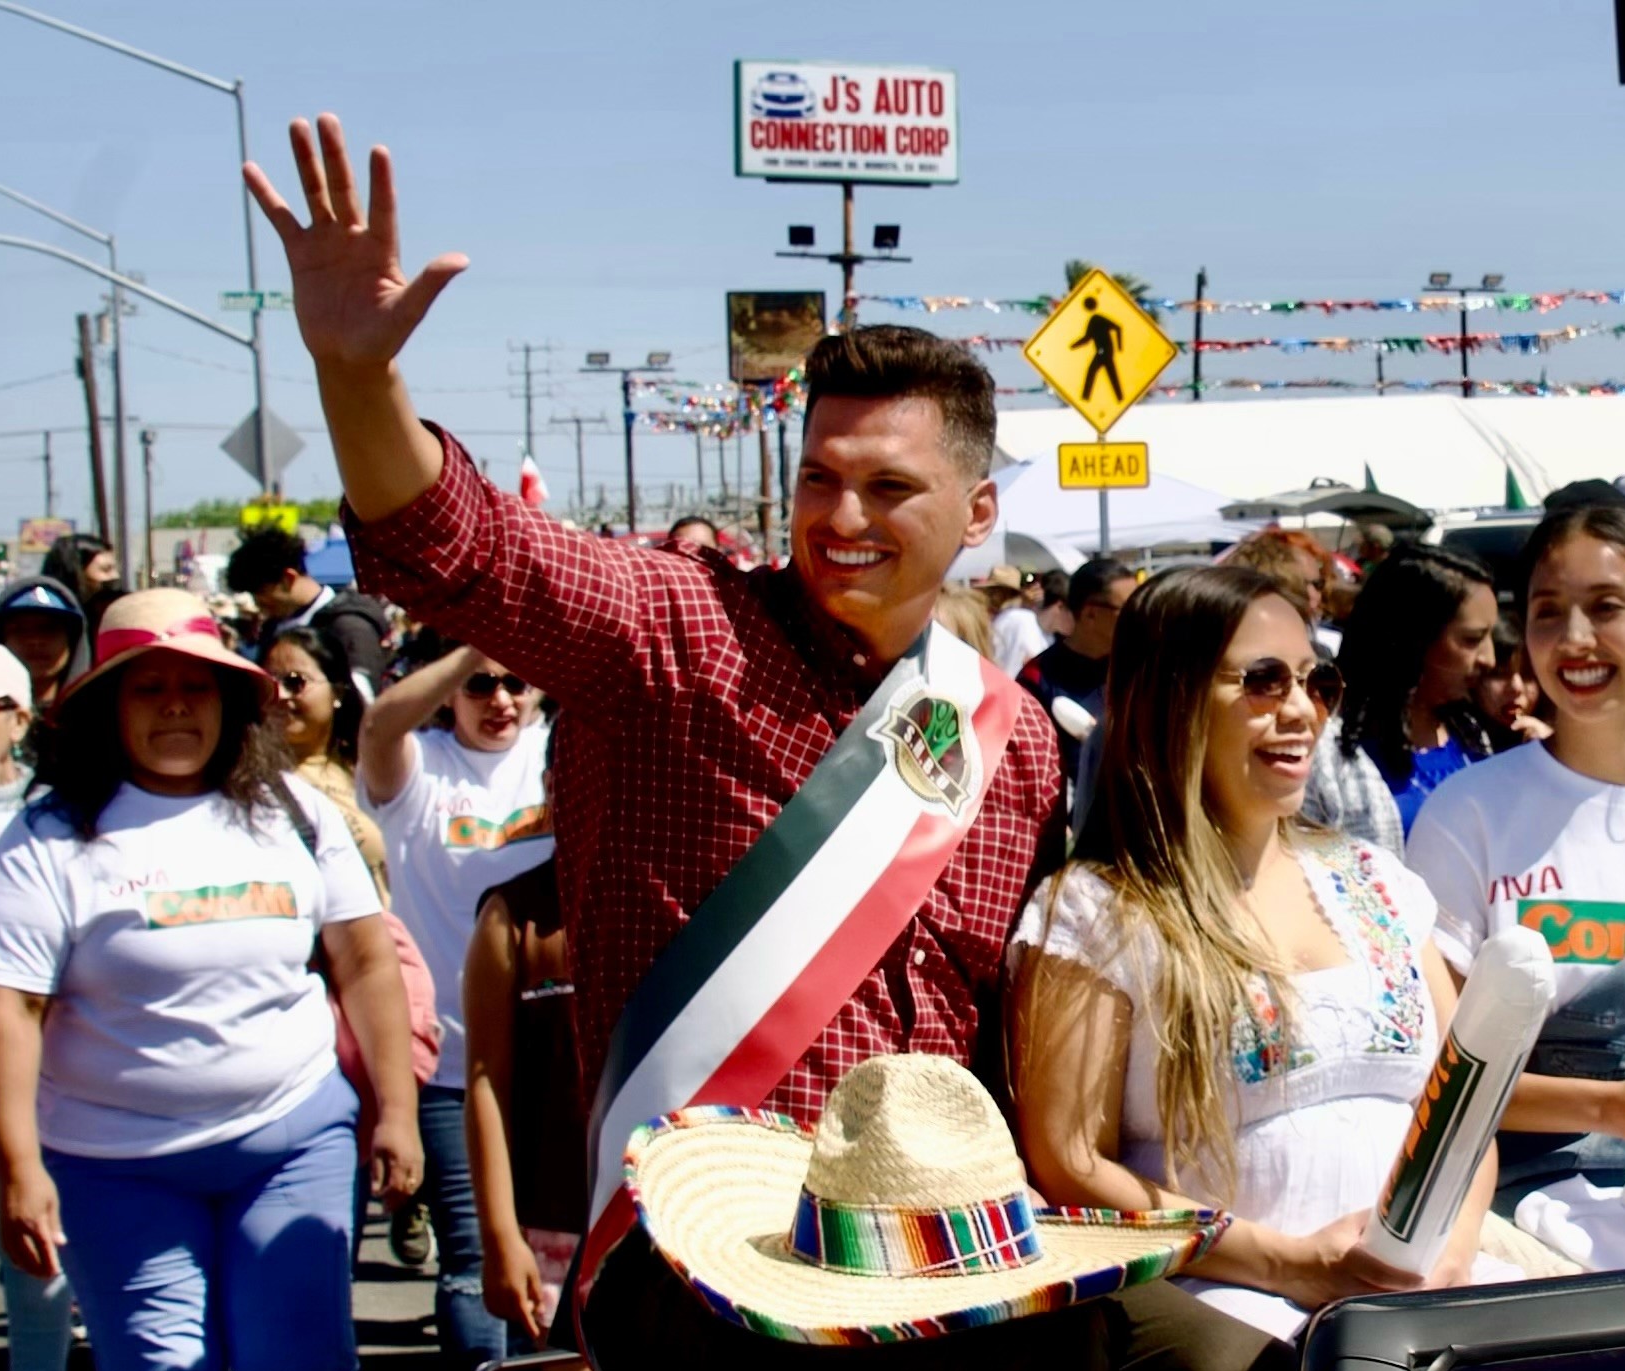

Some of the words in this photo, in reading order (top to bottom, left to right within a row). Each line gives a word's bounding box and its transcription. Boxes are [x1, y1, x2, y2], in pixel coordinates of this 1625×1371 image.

[823, 75, 861, 113] J's
[874, 78, 944, 118] AUTO
[749, 120, 886, 153] CONNECTION
[895, 126, 950, 157] CORP
[1069, 455, 1140, 478] AHEAD
